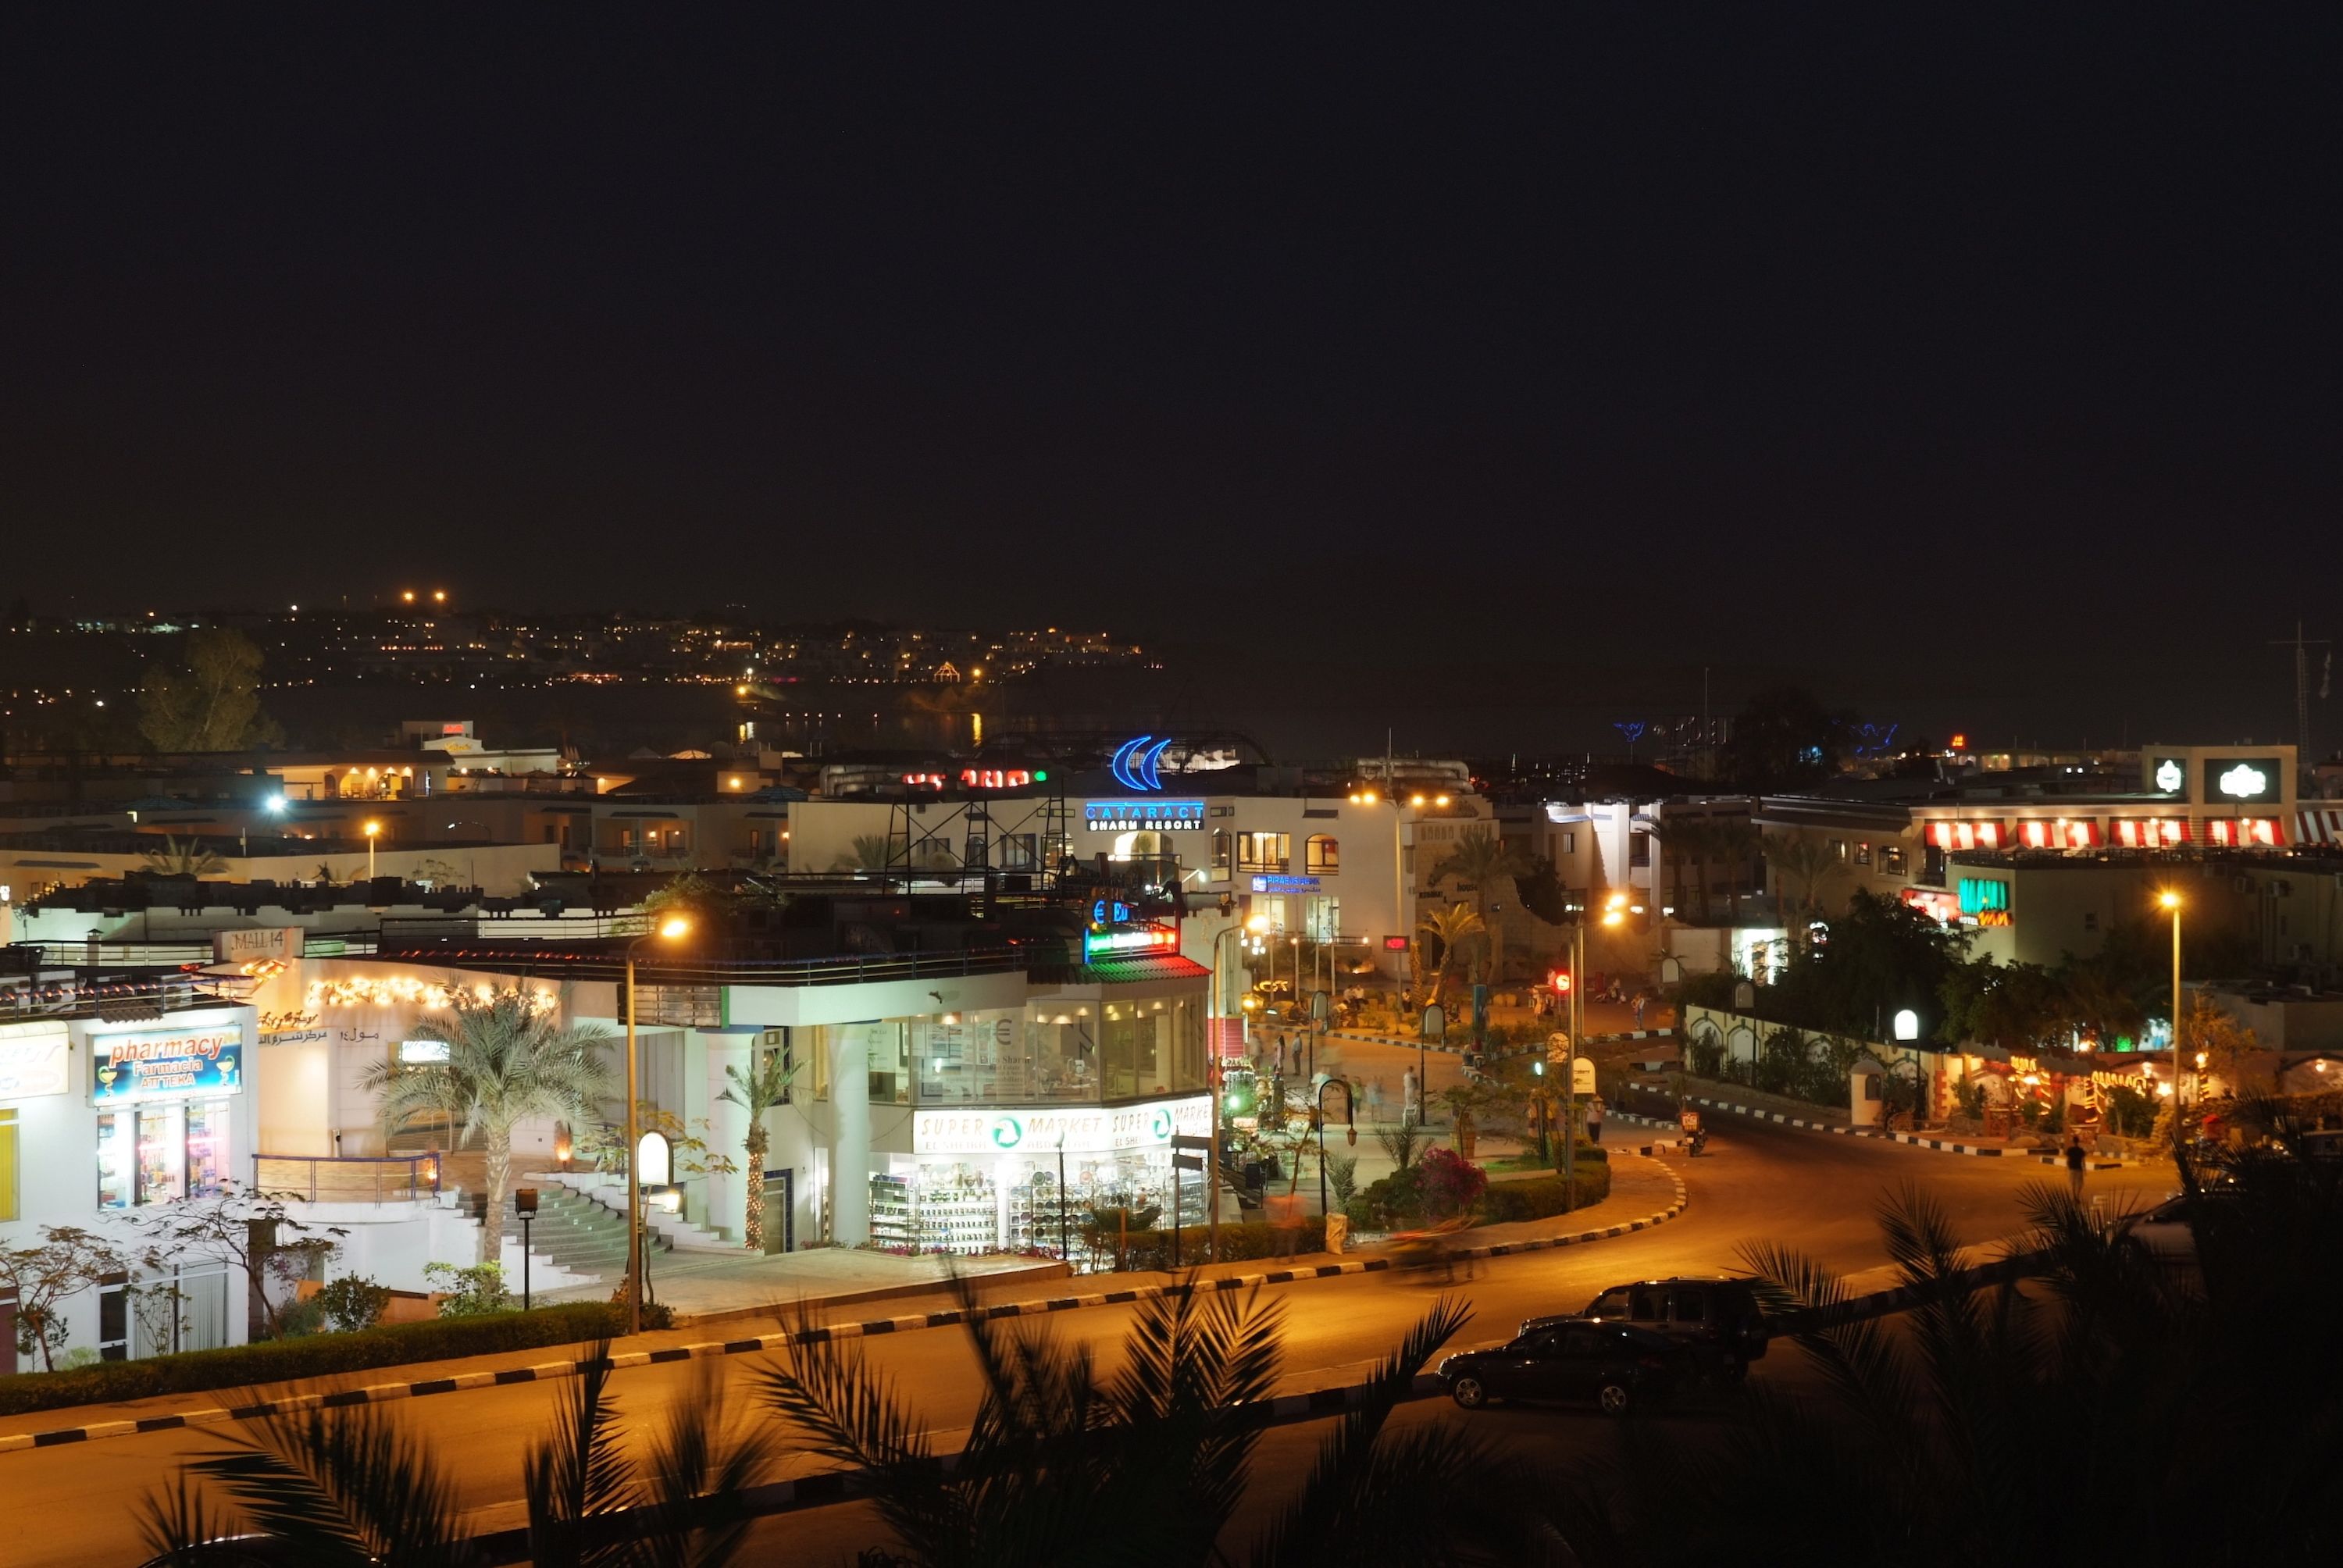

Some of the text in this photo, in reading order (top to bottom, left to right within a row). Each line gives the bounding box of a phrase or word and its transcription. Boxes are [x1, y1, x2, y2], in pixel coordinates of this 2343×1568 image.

[1086, 807, 1204, 819] CATARACT
[1089, 820, 1201, 831] SHARM RESORT
[109, 1036, 224, 1069] pharmacy
[134, 1057, 203, 1077] Farmacia
[922, 1117, 1103, 1136] SUPER MARKET
[1112, 1111, 1150, 1133] SUPER
[1114, 1138, 1122, 1147] EL
